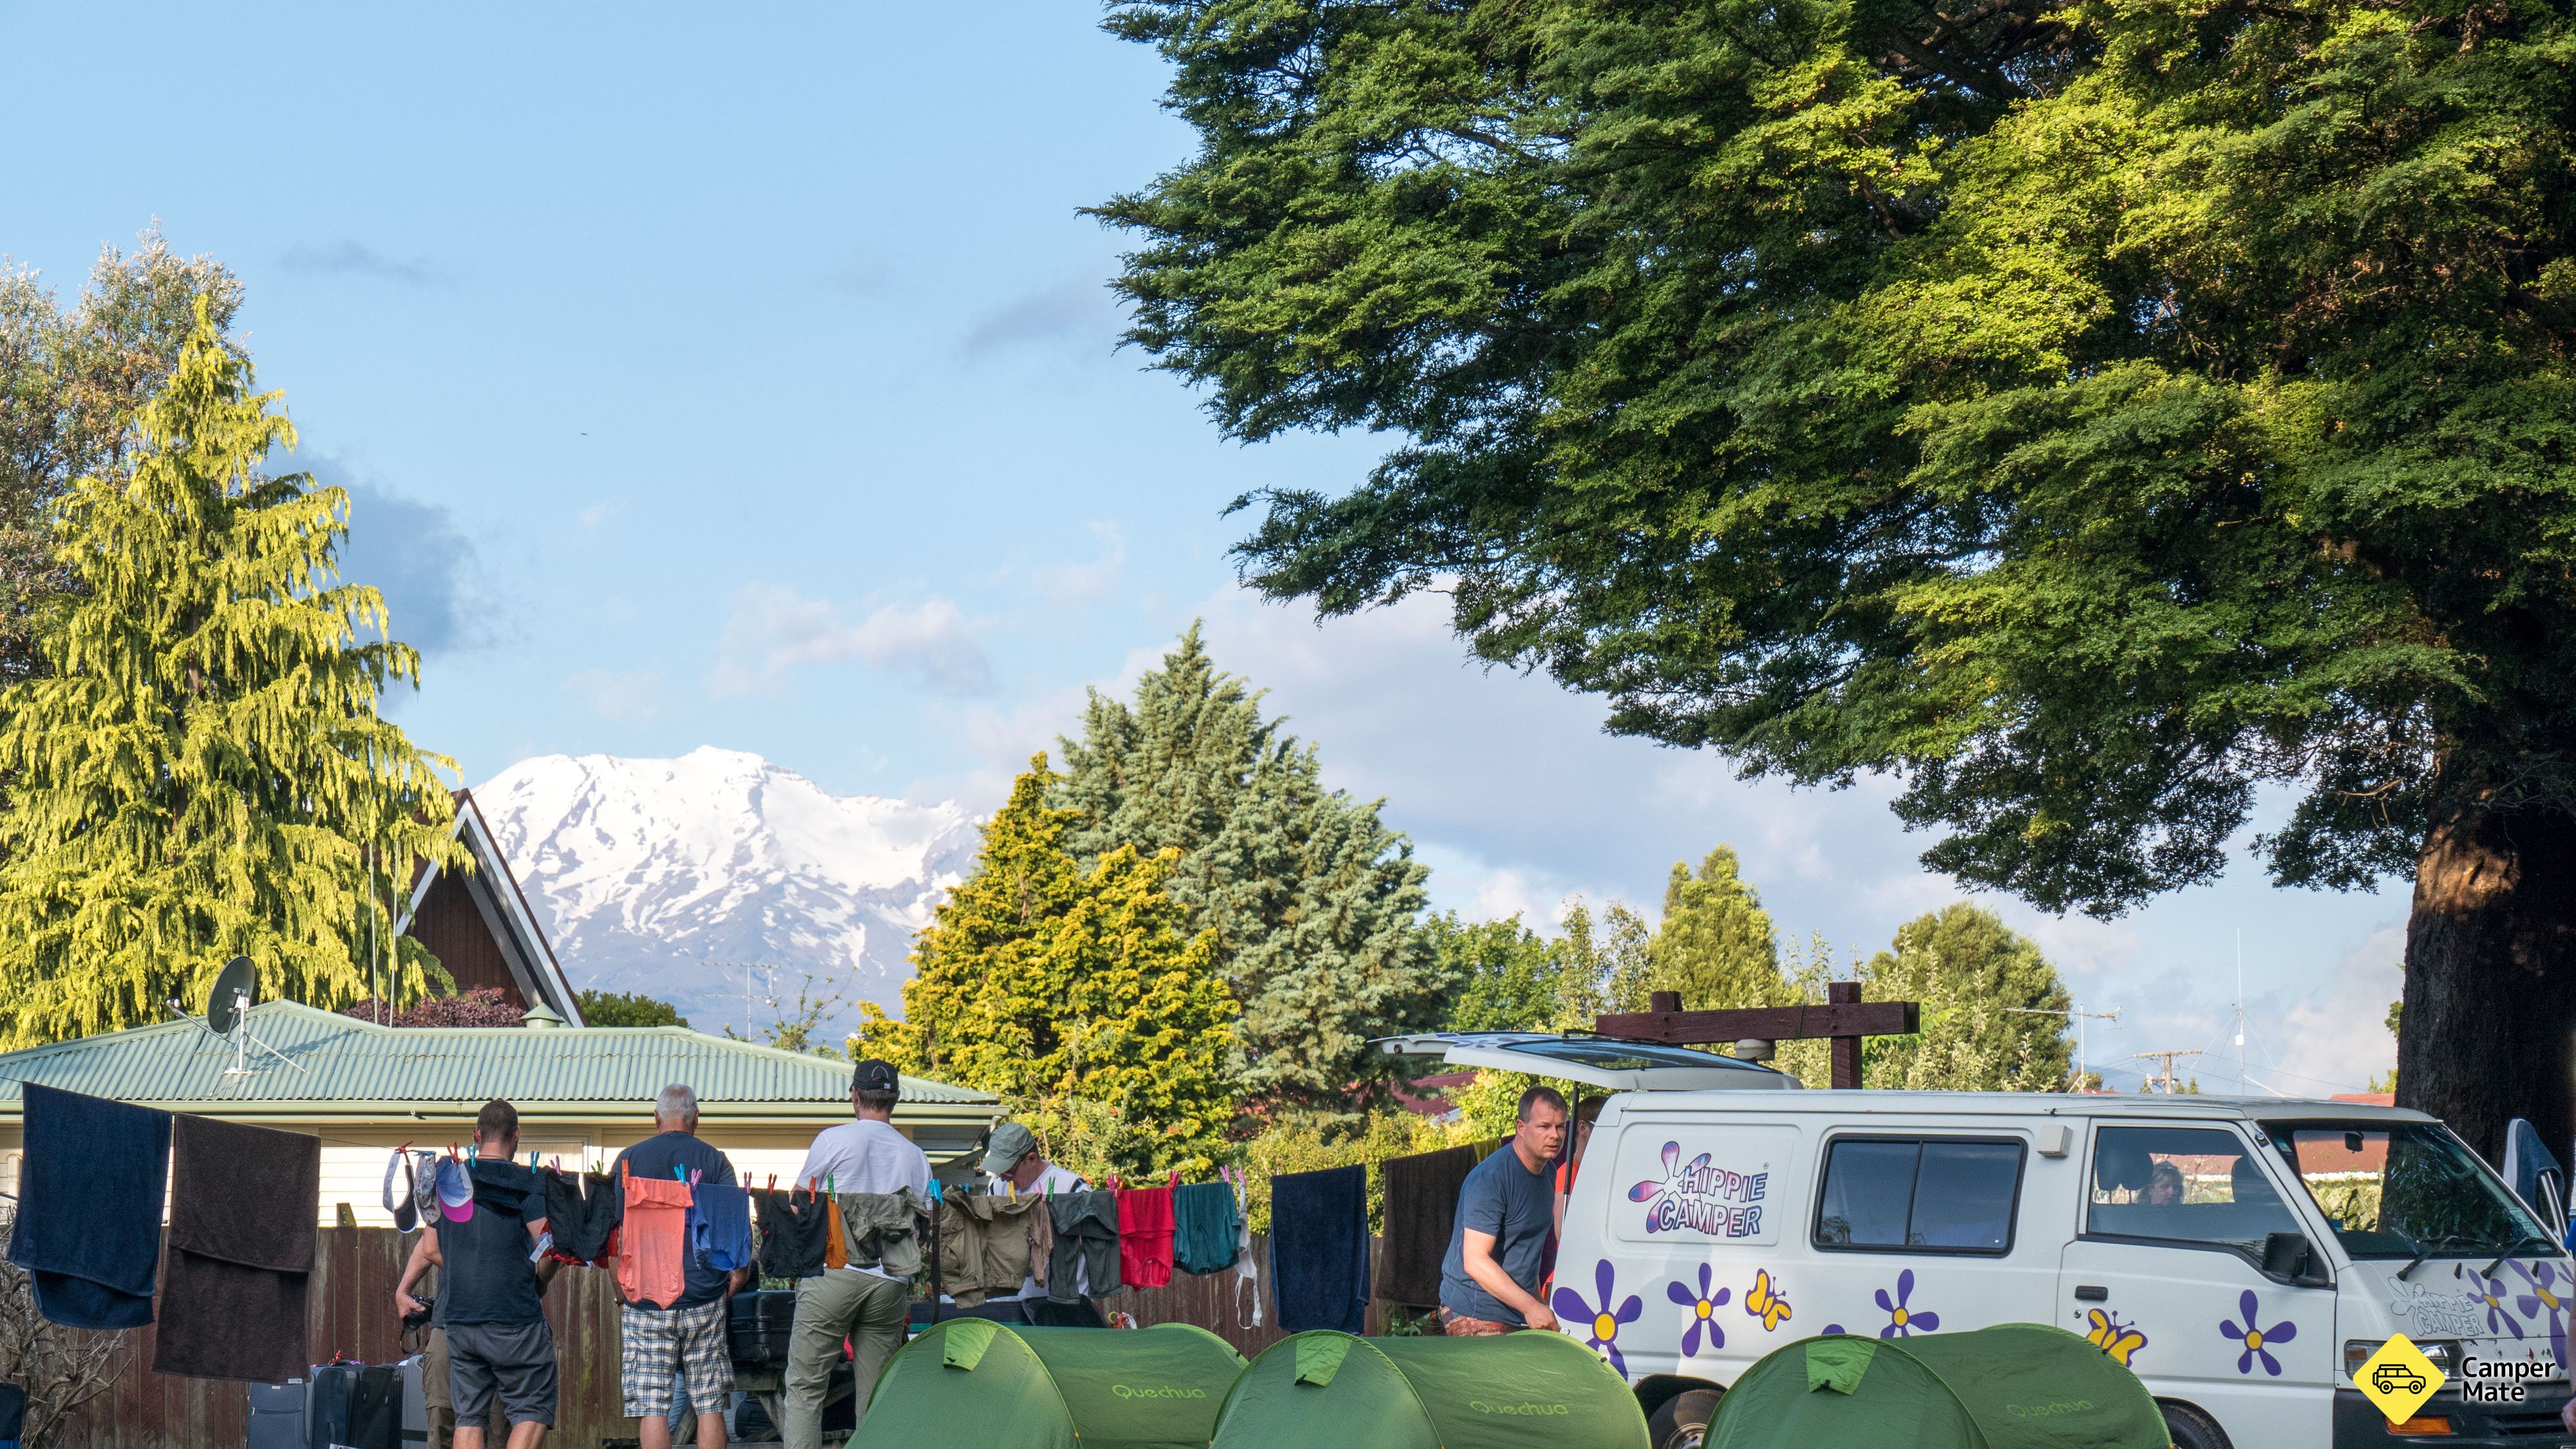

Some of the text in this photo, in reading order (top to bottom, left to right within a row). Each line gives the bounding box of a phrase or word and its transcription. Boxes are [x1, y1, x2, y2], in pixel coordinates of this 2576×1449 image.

[1681, 1166, 1768, 1202] HIPPIE
[1658, 1200, 1762, 1237] CAMPER
[2417, 1312, 2485, 1336] CAMPER
[1112, 1385, 1206, 1399] Quechua
[1470, 1401, 1568, 1416] Quechua
[2007, 1400, 2093, 1419] Quechua
